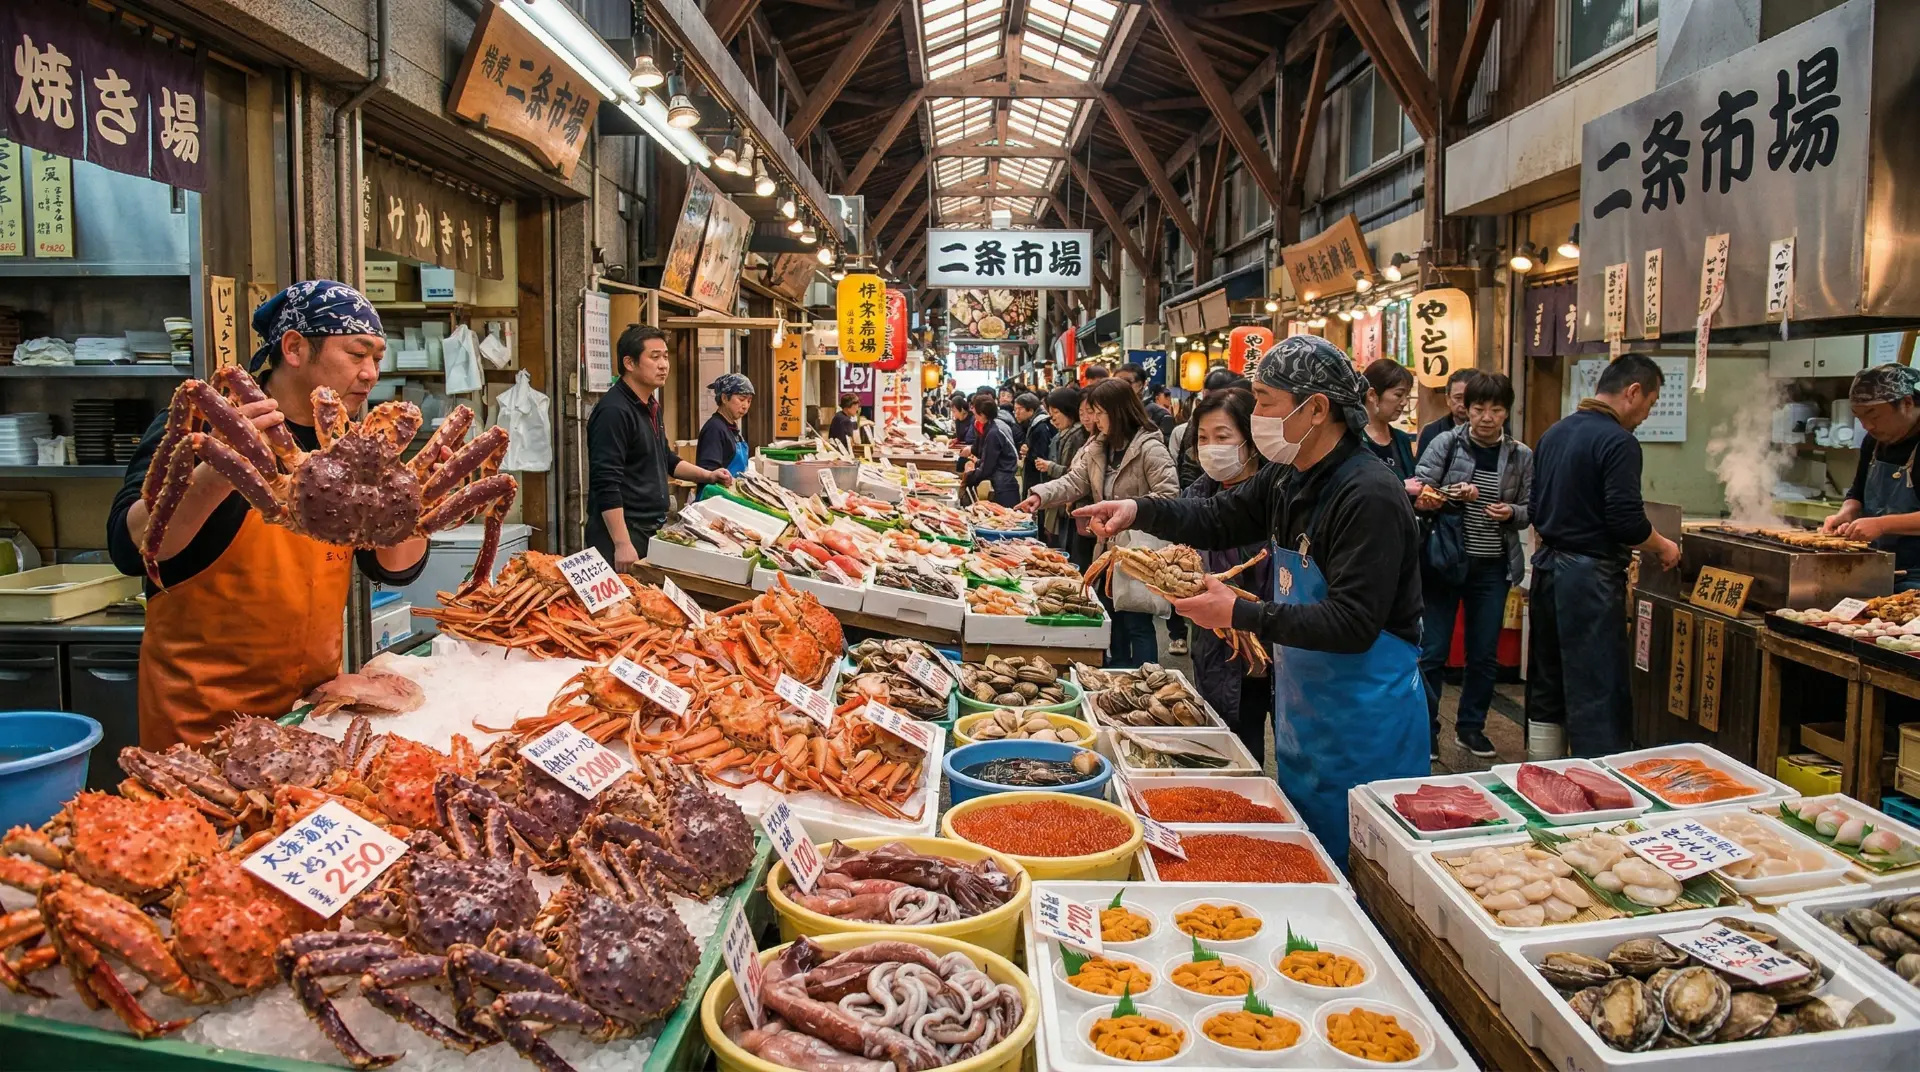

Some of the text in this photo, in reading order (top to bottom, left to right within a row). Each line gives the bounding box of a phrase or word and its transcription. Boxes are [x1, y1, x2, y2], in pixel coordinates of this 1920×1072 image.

[14, 33, 201, 164] 焼き場
[505, 58, 590, 148] 二条市場
[1593, 45, 1842, 220] 二条市場
[937, 240, 1082, 277] 二条市場
[1416, 299, 1449, 377] やとい
[324, 842, 386, 895] 250
[793, 837, 818, 879] 100
